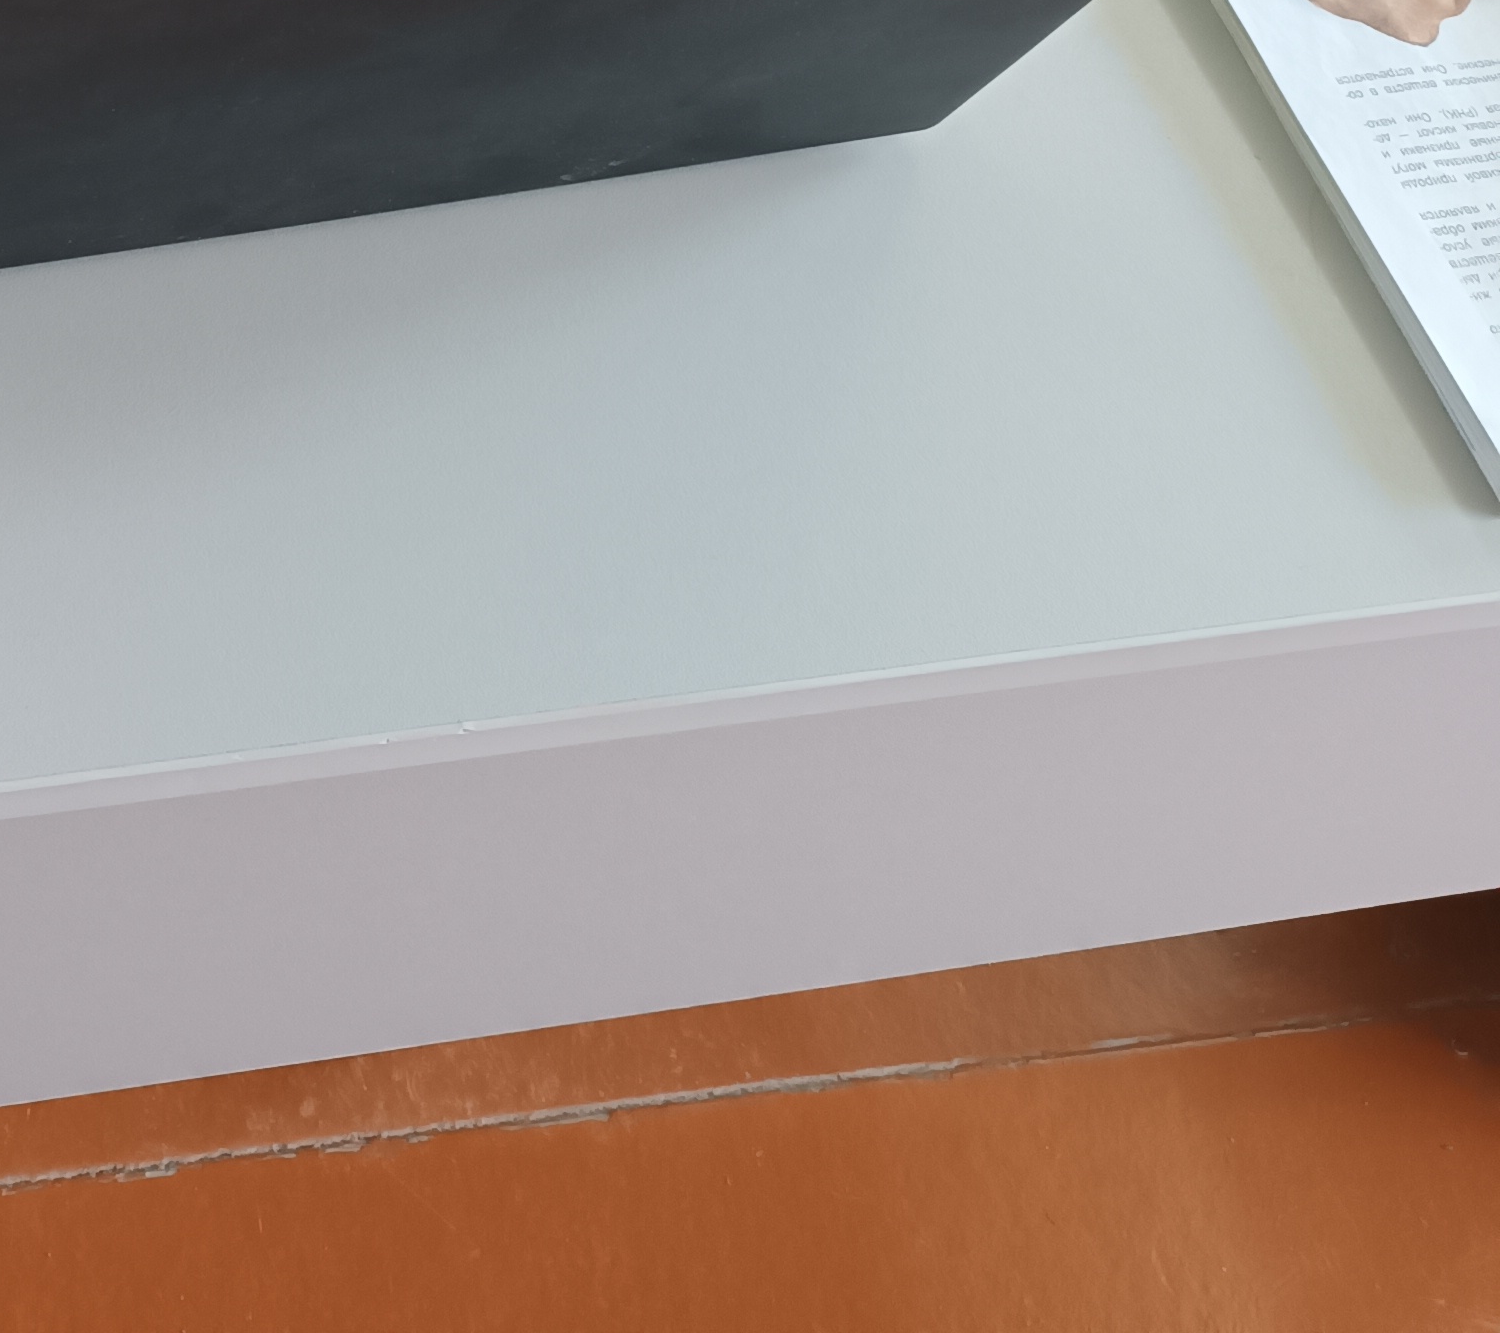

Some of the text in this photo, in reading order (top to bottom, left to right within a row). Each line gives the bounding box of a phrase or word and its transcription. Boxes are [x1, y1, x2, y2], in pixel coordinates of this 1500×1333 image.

[1335, 67, 1414, 84] встречаются
[1421, 64, 1447, 74] Они
[1384, 80, 1437, 93] веществ
[1405, 113, 1431, 123] Они
[1416, 125, 1457, 137] кислот
[1400, 140, 1460, 156] признаки
[1391, 162, 1427, 174] могут
[1400, 173, 1457, 189] природы
[1419, 206, 1480, 220] являются
